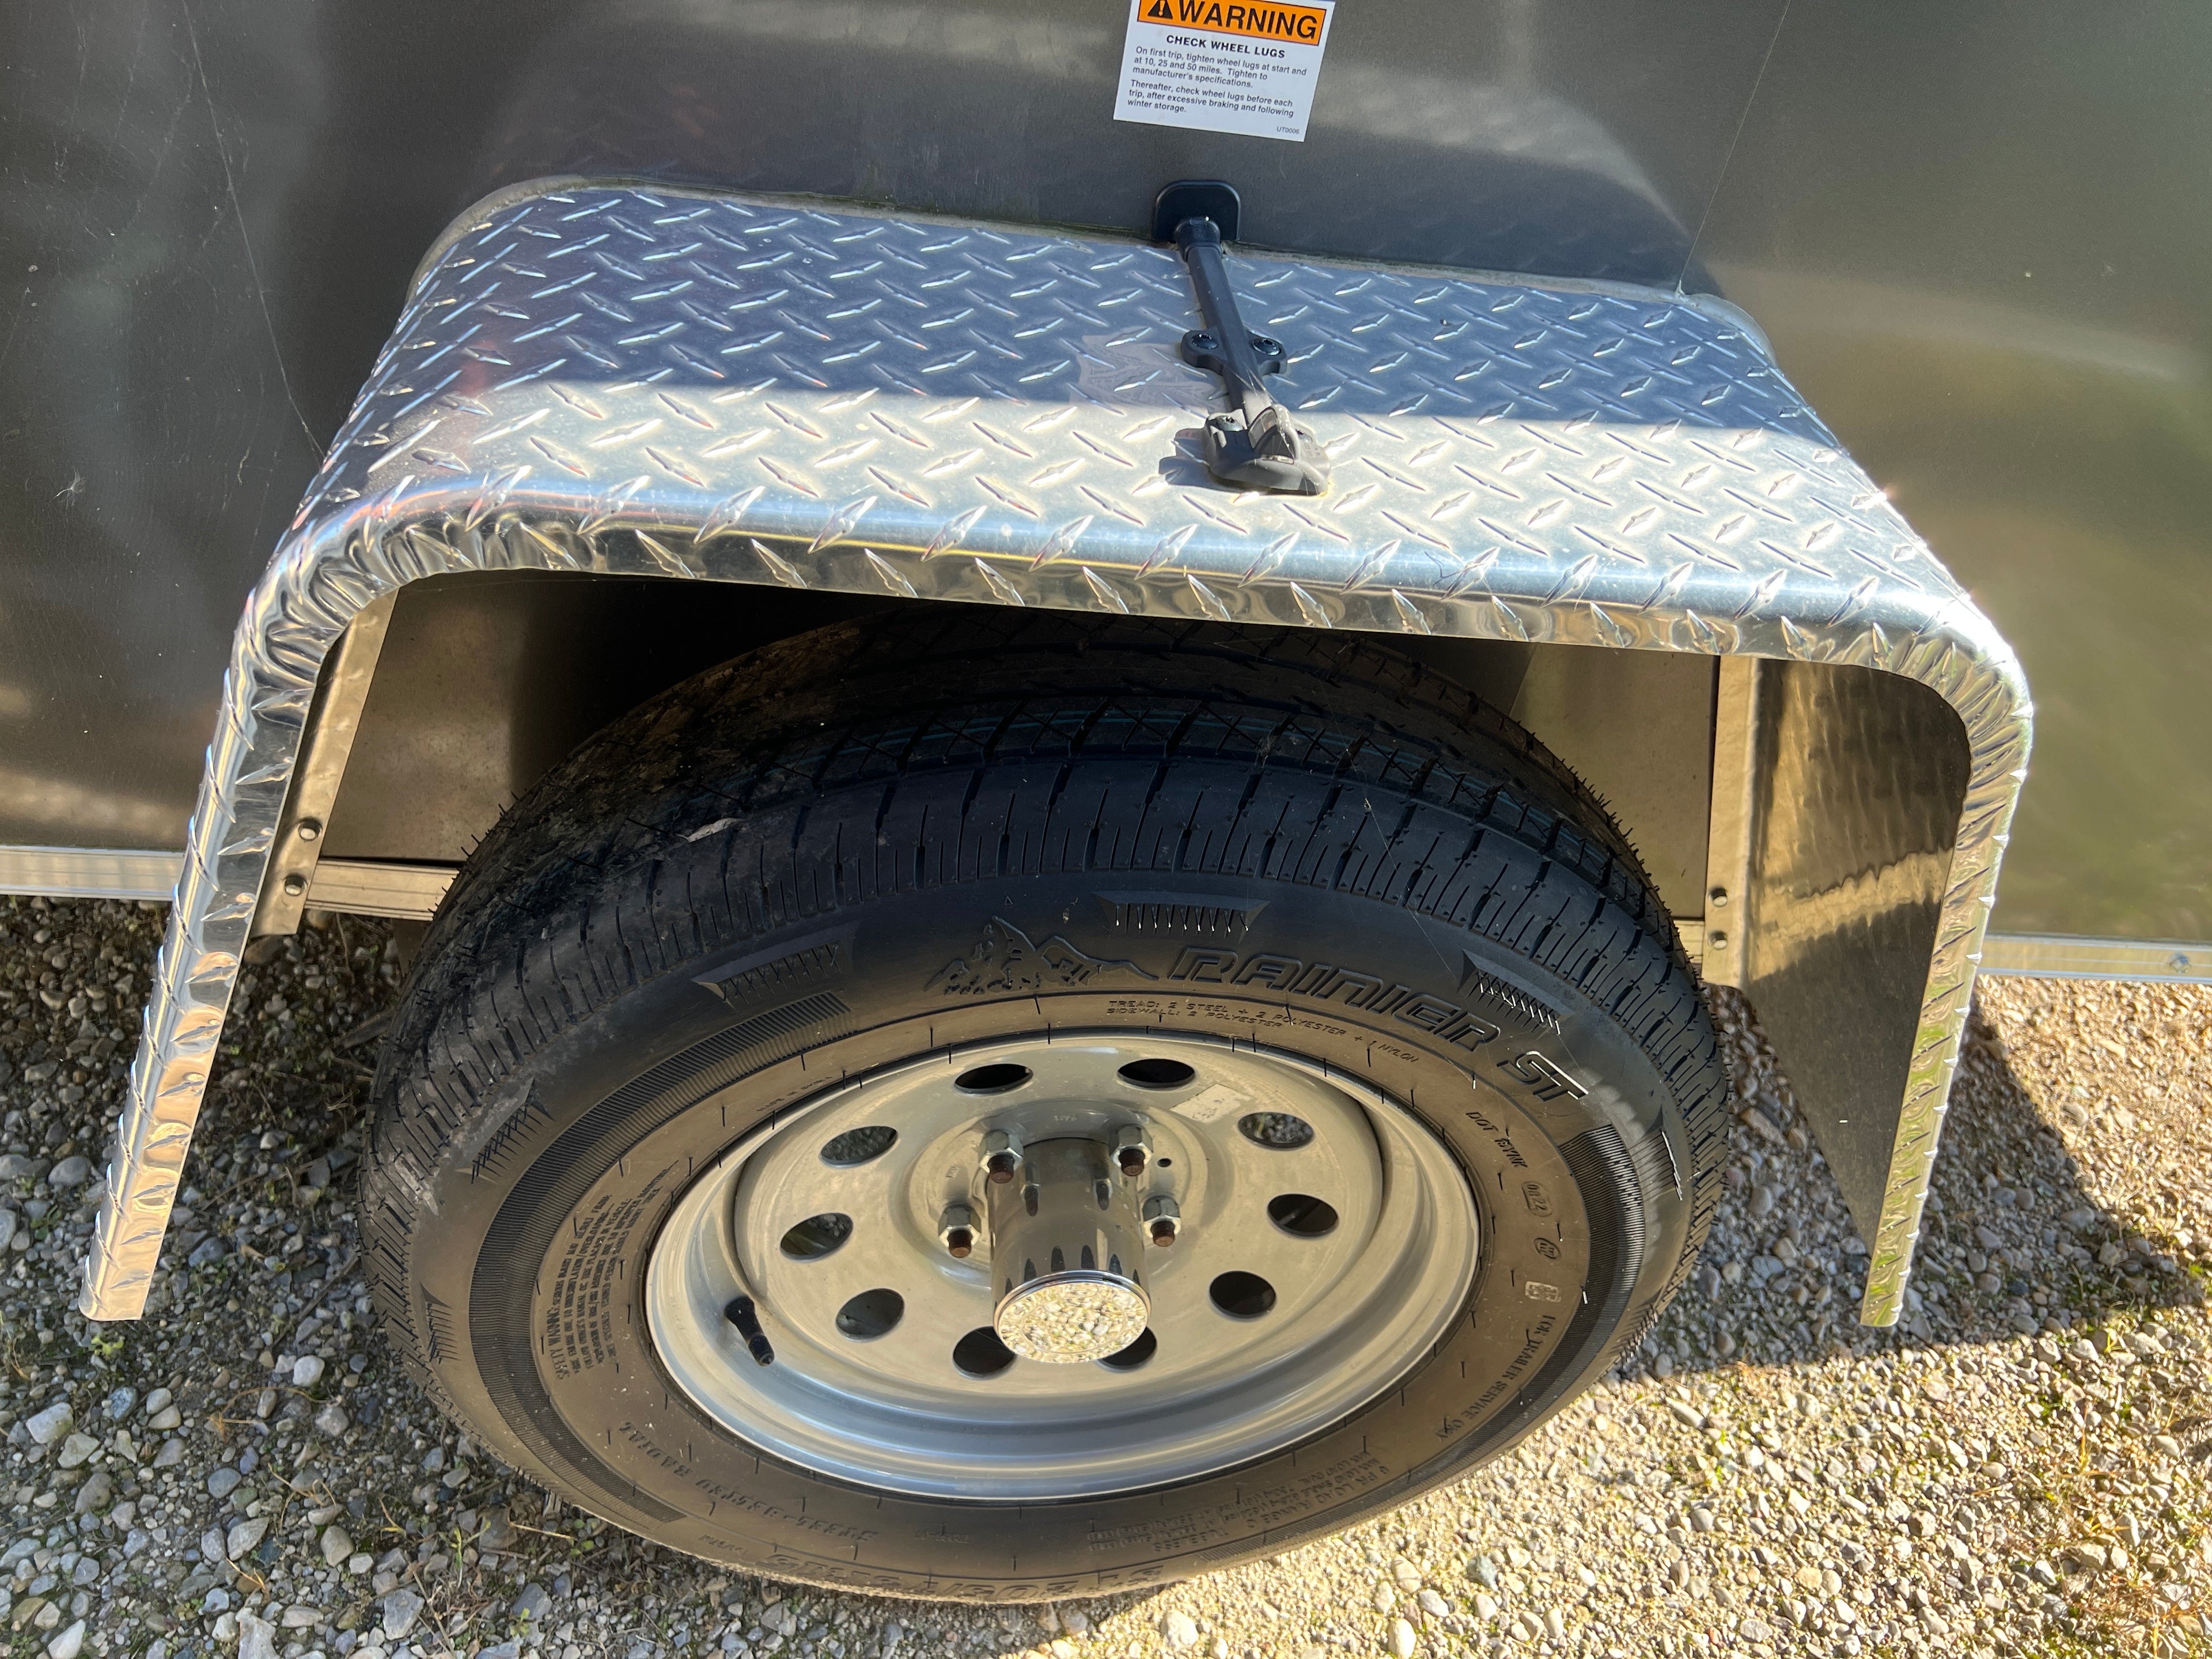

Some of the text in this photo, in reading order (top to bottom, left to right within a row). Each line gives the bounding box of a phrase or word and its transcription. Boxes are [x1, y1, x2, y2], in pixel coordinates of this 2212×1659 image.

[1179, 0, 1317, 40] WARNING
[1136, 46, 1147, 55] On
[1150, 48, 1166, 57] first
[1168, 51, 1184, 60] trip,
[1187, 53, 1214, 63] tighten
[1217, 58, 1240, 67] wheel
[1243, 60, 1260, 70] lugs
[1272, 65, 1290, 74] start
[1166, 35, 1285, 58] CHECK WHEEL LUGS
[1132, 67, 1253, 88] manufacturer's specifications.
[1145, 58, 1156, 66] 10,
[1158, 59, 1168, 67] 25
[1199, 65, 1222, 74] miles.
[1228, 68, 1257, 79] Tighten
[1129, 89, 1145, 99] trip,
[1147, 92, 1165, 100] after
[1167, 95, 1207, 105] excessive
[1209, 99, 1238, 111] braking
[1258, 105, 1294, 118] following
[1131, 79, 1173, 92] Thereafter,
[1176, 86, 1200, 95] check
[1202, 89, 1225, 98] wheel
[1227, 92, 1244, 101] lugs
[1247, 94, 1272, 104] before
[1128, 99, 1187, 113] winter storage.
[1168, 948, 1589, 1103] RAINIER ST
[1186, 1003, 1228, 1012] STEEL
[1272, 1014, 1347, 1036] POLYESTER
[1378, 1044, 1419, 1062] NYLON
[1205, 1012, 1283, 1028] POLYESTER
[1465, 1111, 1499, 1132] DOT
[550, 1348, 570, 1380] SAFETY
[1502, 1339, 1543, 1380] TRAILER
[1461, 1381, 1508, 1419] SERVICE
[619, 1422, 693, 1479] RADIAL
